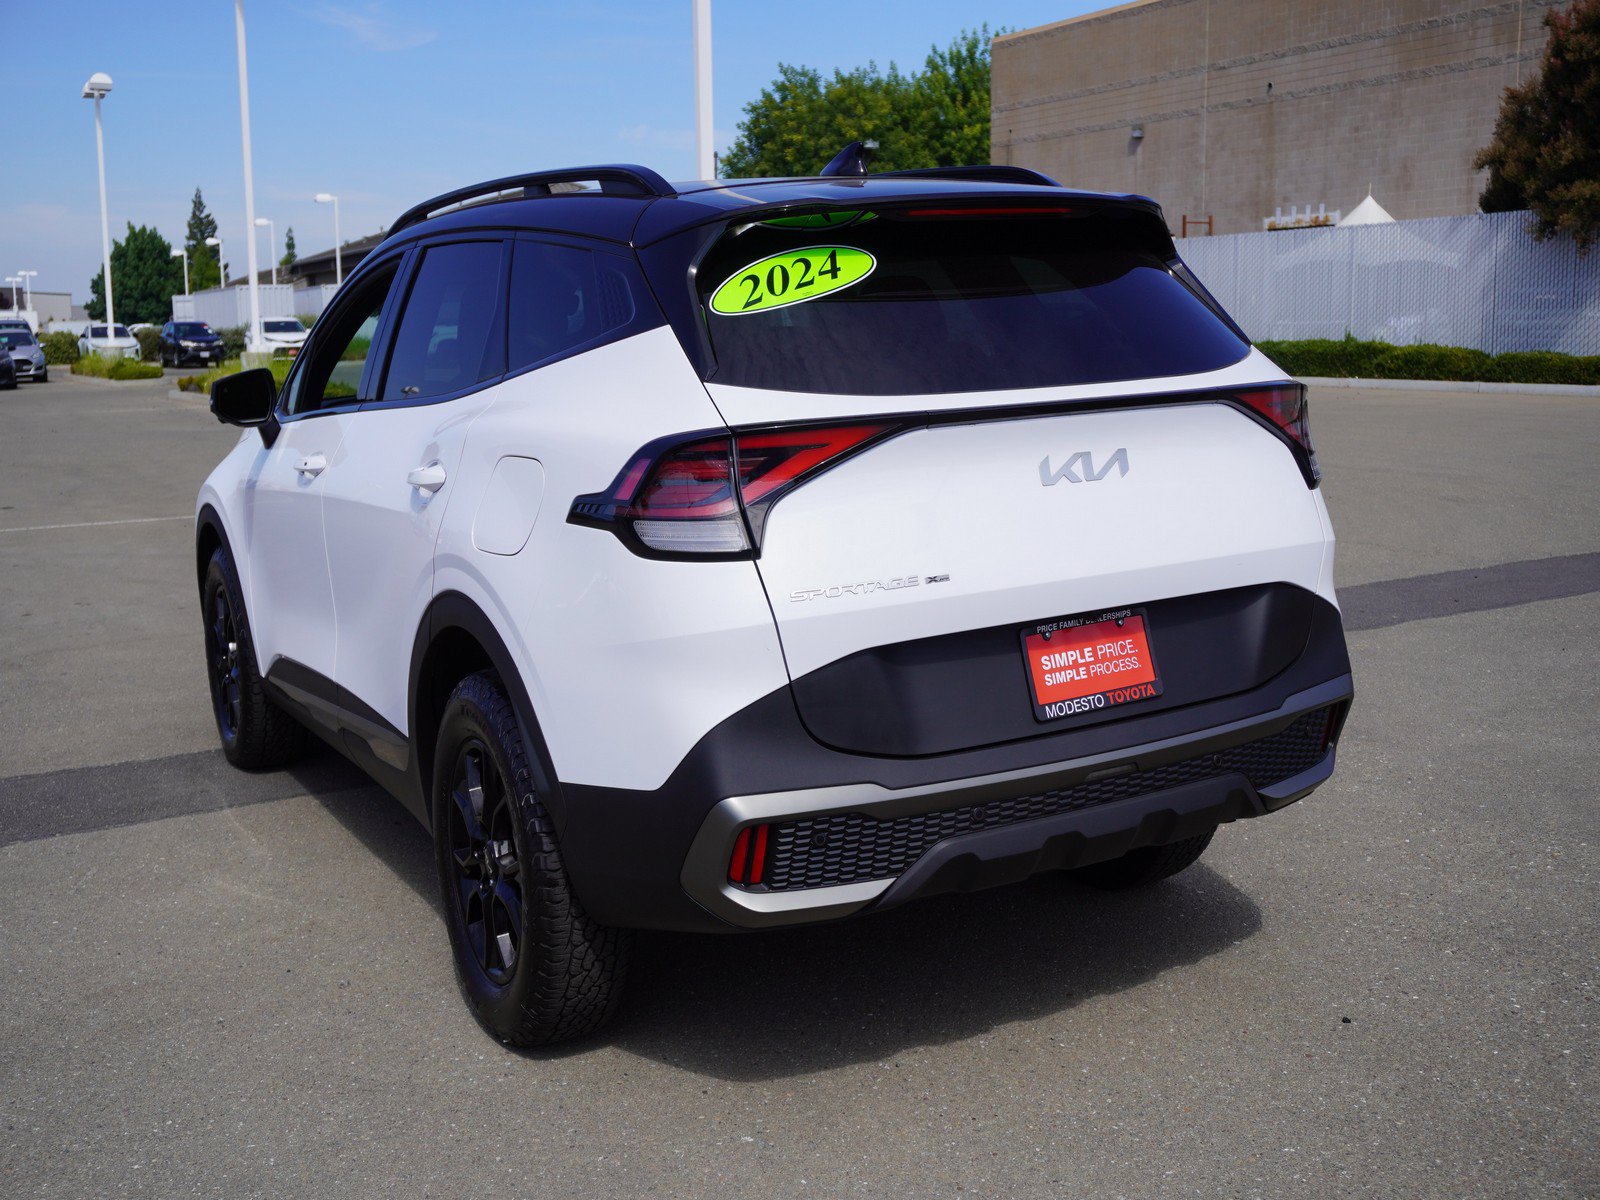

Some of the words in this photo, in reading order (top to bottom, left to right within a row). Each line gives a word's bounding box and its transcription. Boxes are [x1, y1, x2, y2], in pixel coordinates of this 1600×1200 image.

[739, 249, 841, 310] 2024
[1039, 448, 1130, 487] KIA
[790, 576, 919, 602] SPORTAGE
[1036, 623, 1058, 634] PRICE
[1059, 618, 1084, 630] FAMILY
[1041, 647, 1095, 671] SIMPLE
[1096, 639, 1139, 661] PRICE.
[1044, 666, 1088, 687] SIMPLE
[1090, 656, 1142, 678] PROCESS.
[1045, 694, 1105, 719] MODESTO
[1106, 683, 1156, 706] TOYOTA
